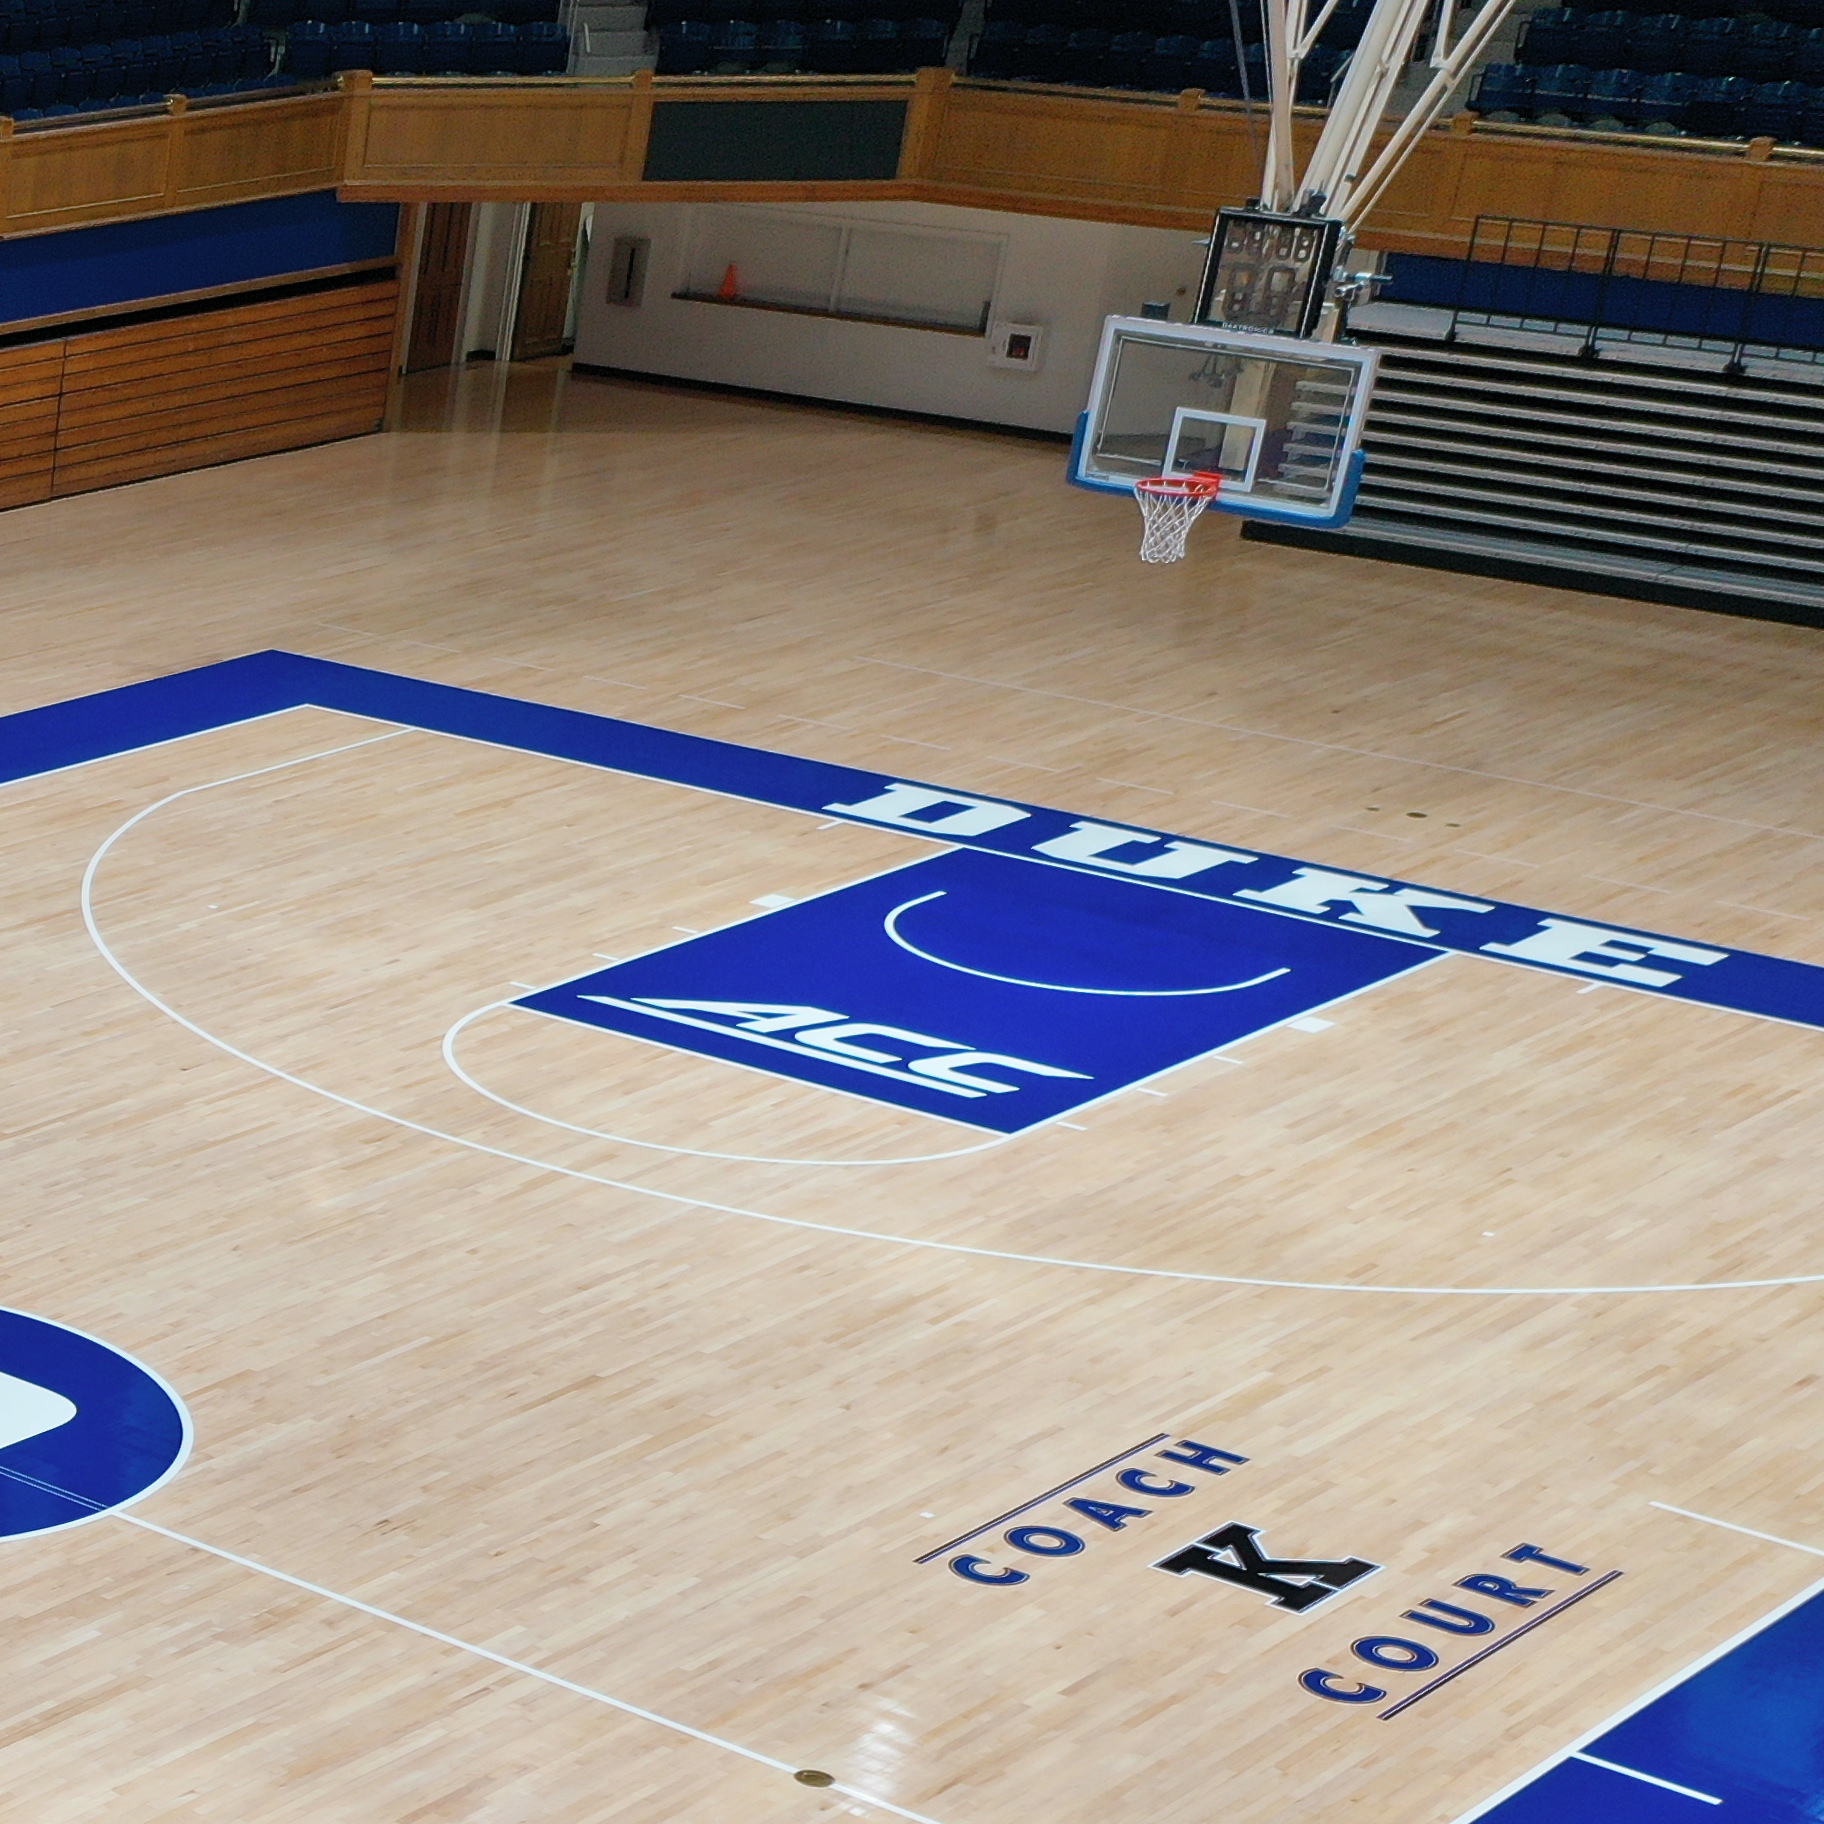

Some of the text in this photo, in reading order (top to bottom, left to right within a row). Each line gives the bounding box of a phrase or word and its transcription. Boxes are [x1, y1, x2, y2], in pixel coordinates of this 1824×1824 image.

[823, 783, 1728, 988] DUKE
[577, 994, 1094, 1098] ACC
[946, 1439, 1250, 1587] COACH
[1149, 1521, 1383, 1614] K
[1297, 1542, 1591, 1706] COURT
